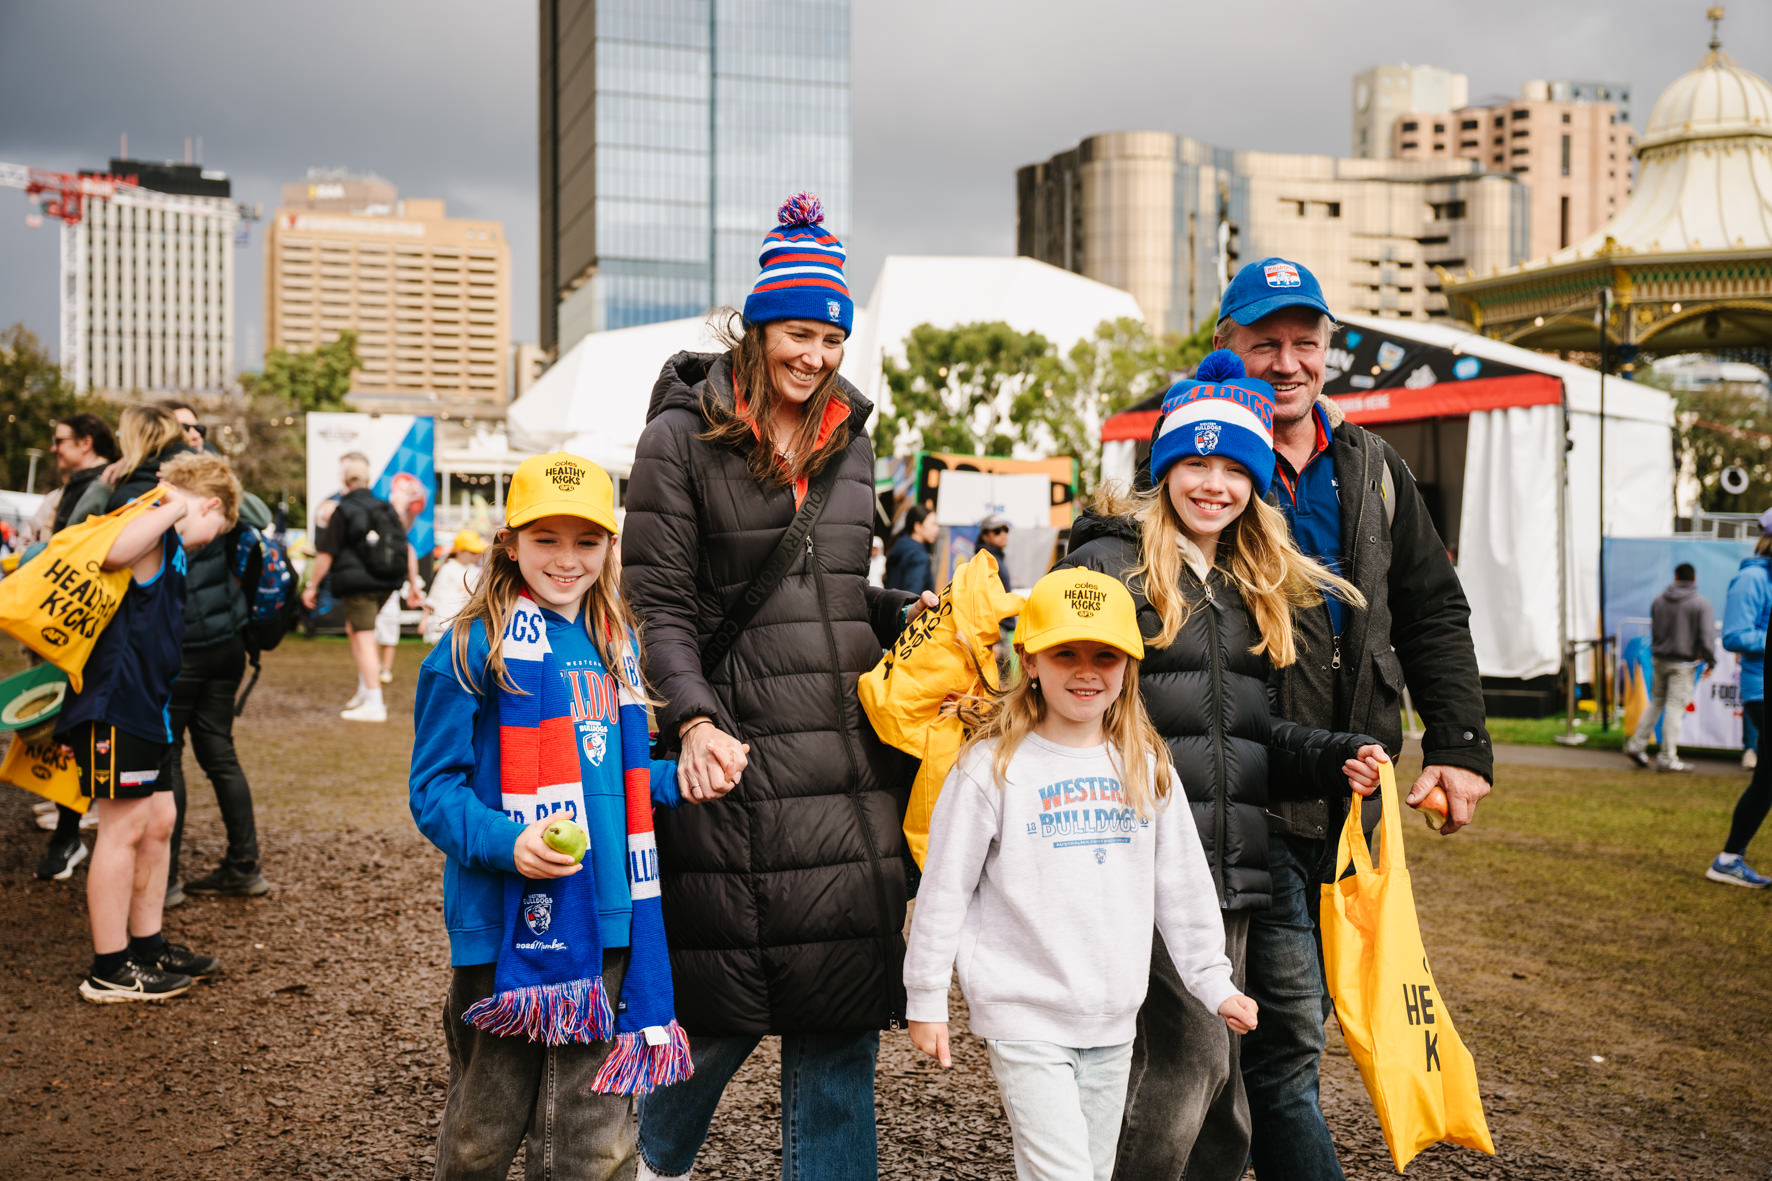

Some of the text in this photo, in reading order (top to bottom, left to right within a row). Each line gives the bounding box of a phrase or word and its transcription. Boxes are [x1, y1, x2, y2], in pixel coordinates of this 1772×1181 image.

[545, 466, 586, 479] HEALTHY
[555, 460, 578, 468] coles
[552, 475, 581, 486] KICKS
[43, 558, 117, 619] HEALTHY
[1064, 589, 1107, 603] HEALTHY
[1074, 582, 1099, 590] coles
[39, 589, 100, 639] KICKS
[1071, 599, 1101, 611] KICKS
[899, 602, 953, 661] coles
[1038, 807, 1139, 838] BULLDOGS
[1402, 983, 1435, 1026] HE
[1424, 1029, 1441, 1073] K
